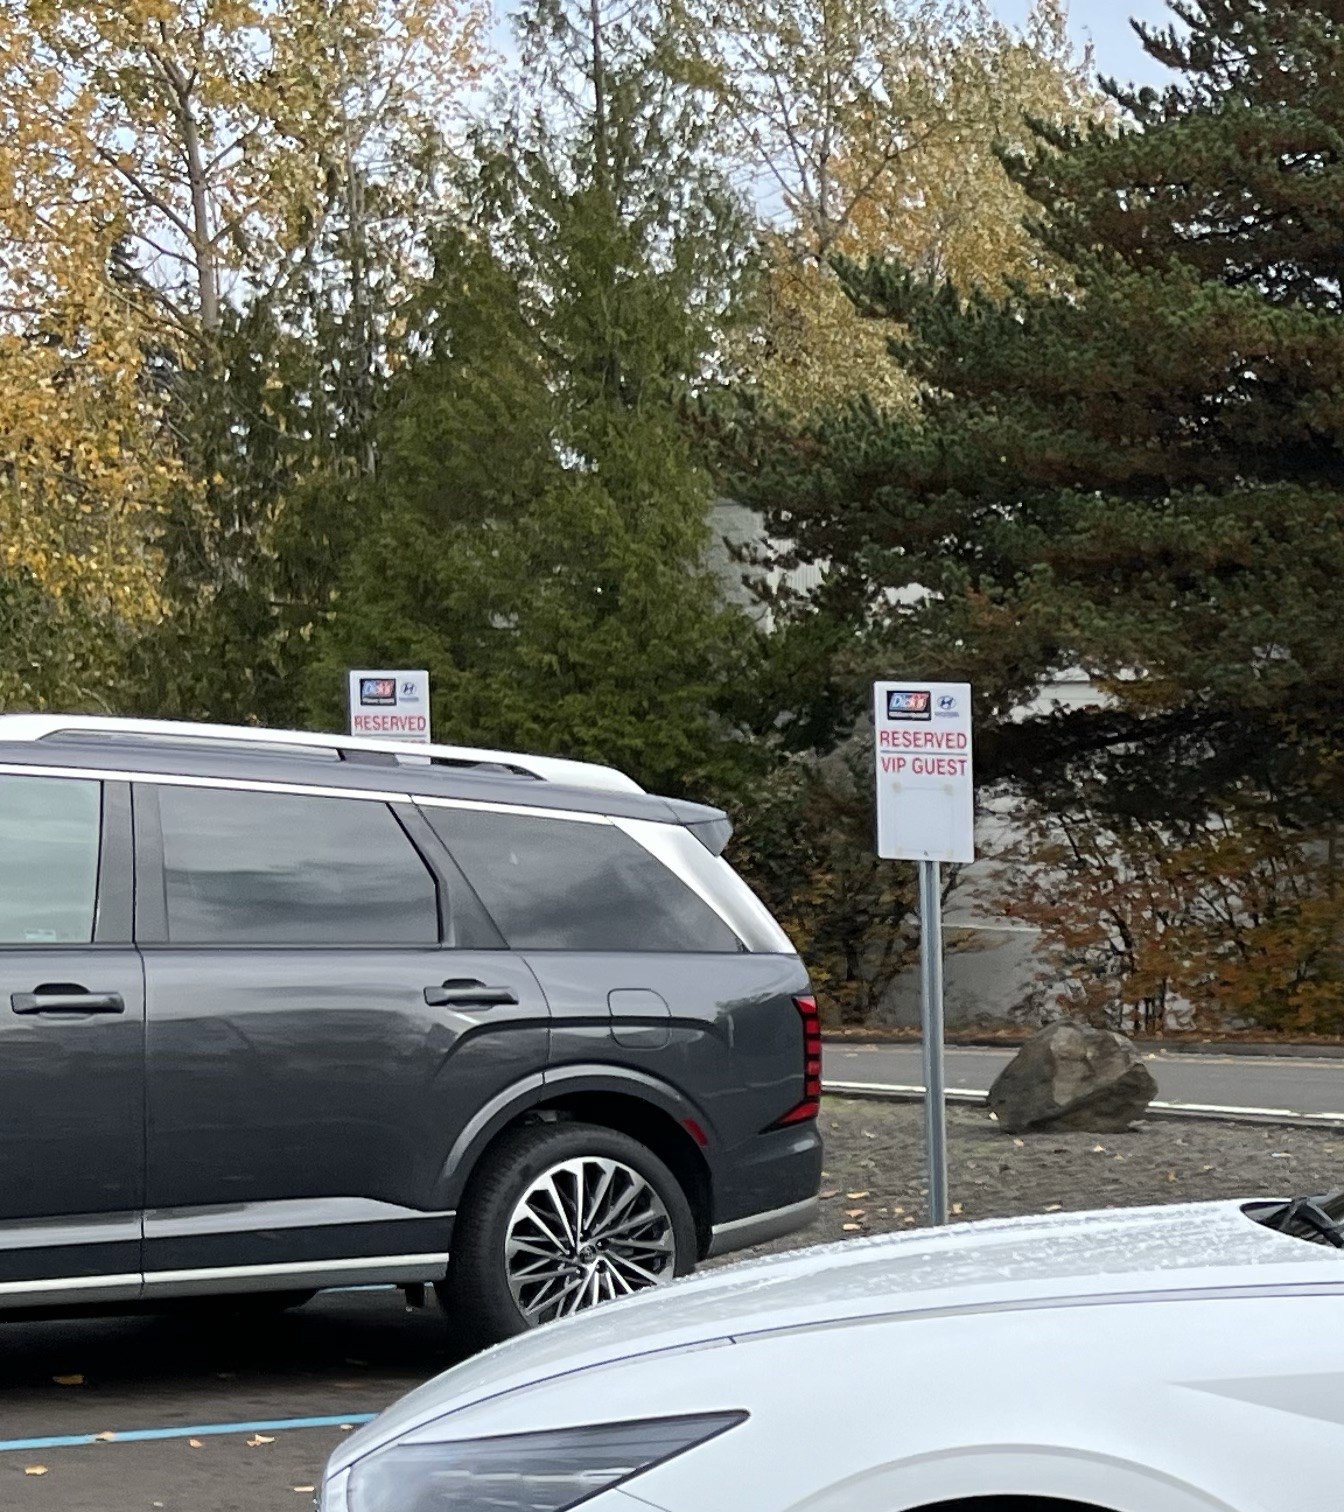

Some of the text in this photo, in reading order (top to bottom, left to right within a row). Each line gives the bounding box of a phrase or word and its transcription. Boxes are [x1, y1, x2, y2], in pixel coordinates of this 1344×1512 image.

[354, 715, 427, 731] RESERVED
[880, 730, 967, 750] RESERVED
[881, 756, 968, 776] VIP GUEST
